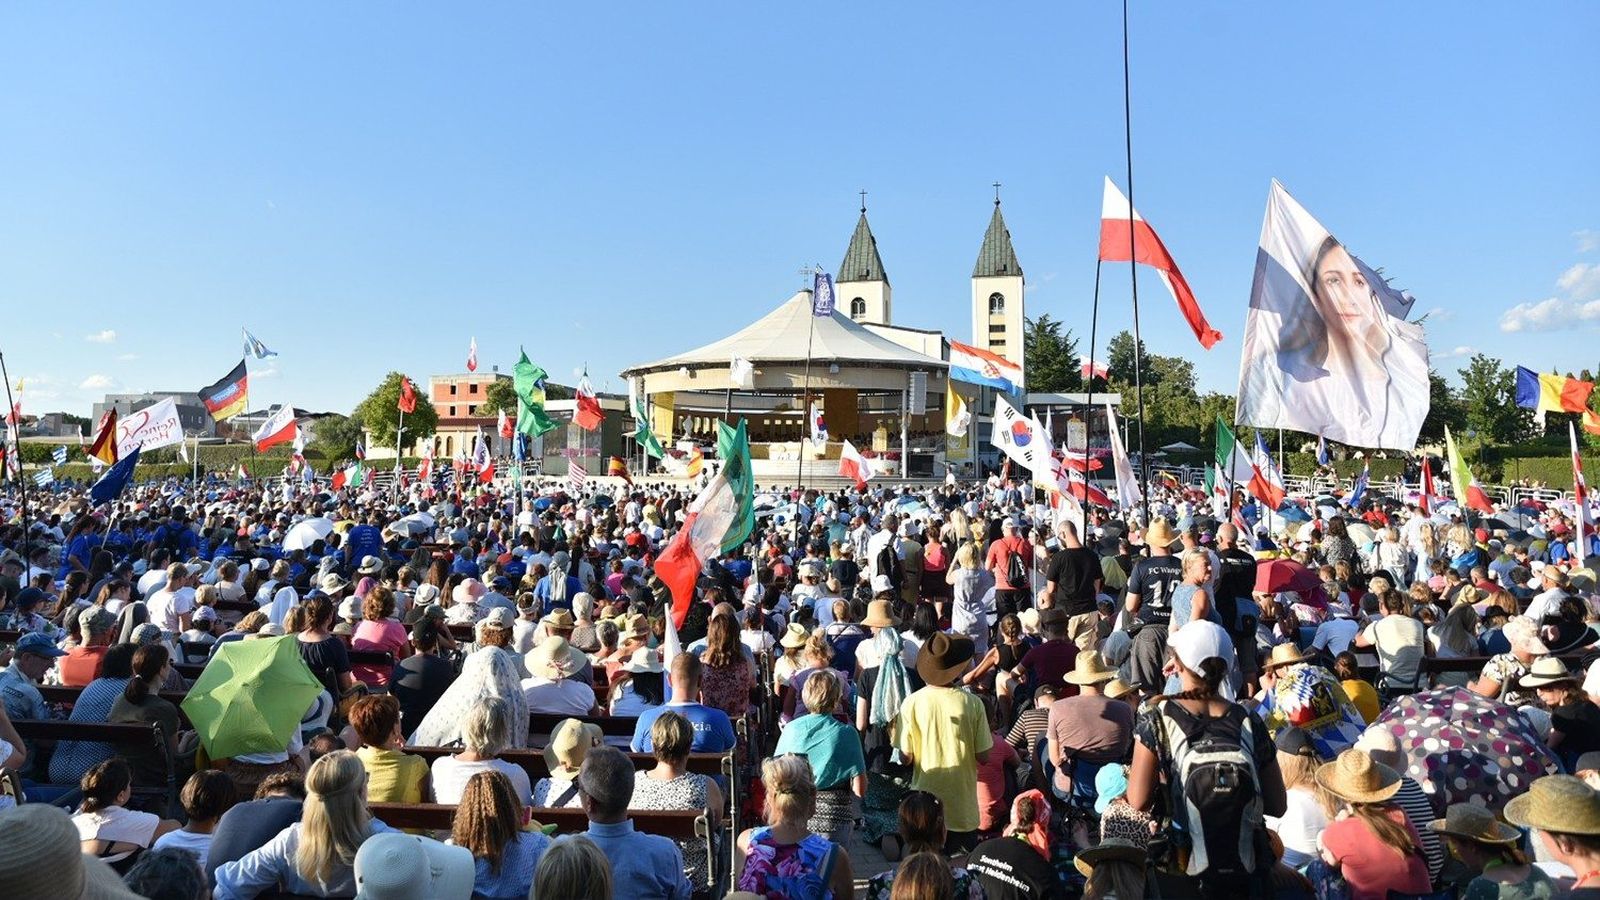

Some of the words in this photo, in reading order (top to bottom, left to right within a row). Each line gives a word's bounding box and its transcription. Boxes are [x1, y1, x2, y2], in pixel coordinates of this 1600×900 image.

[1148, 566, 1160, 575] FC
[979, 854, 1013, 872] Sontheim
[984, 866, 1030, 892] Heidenheim
